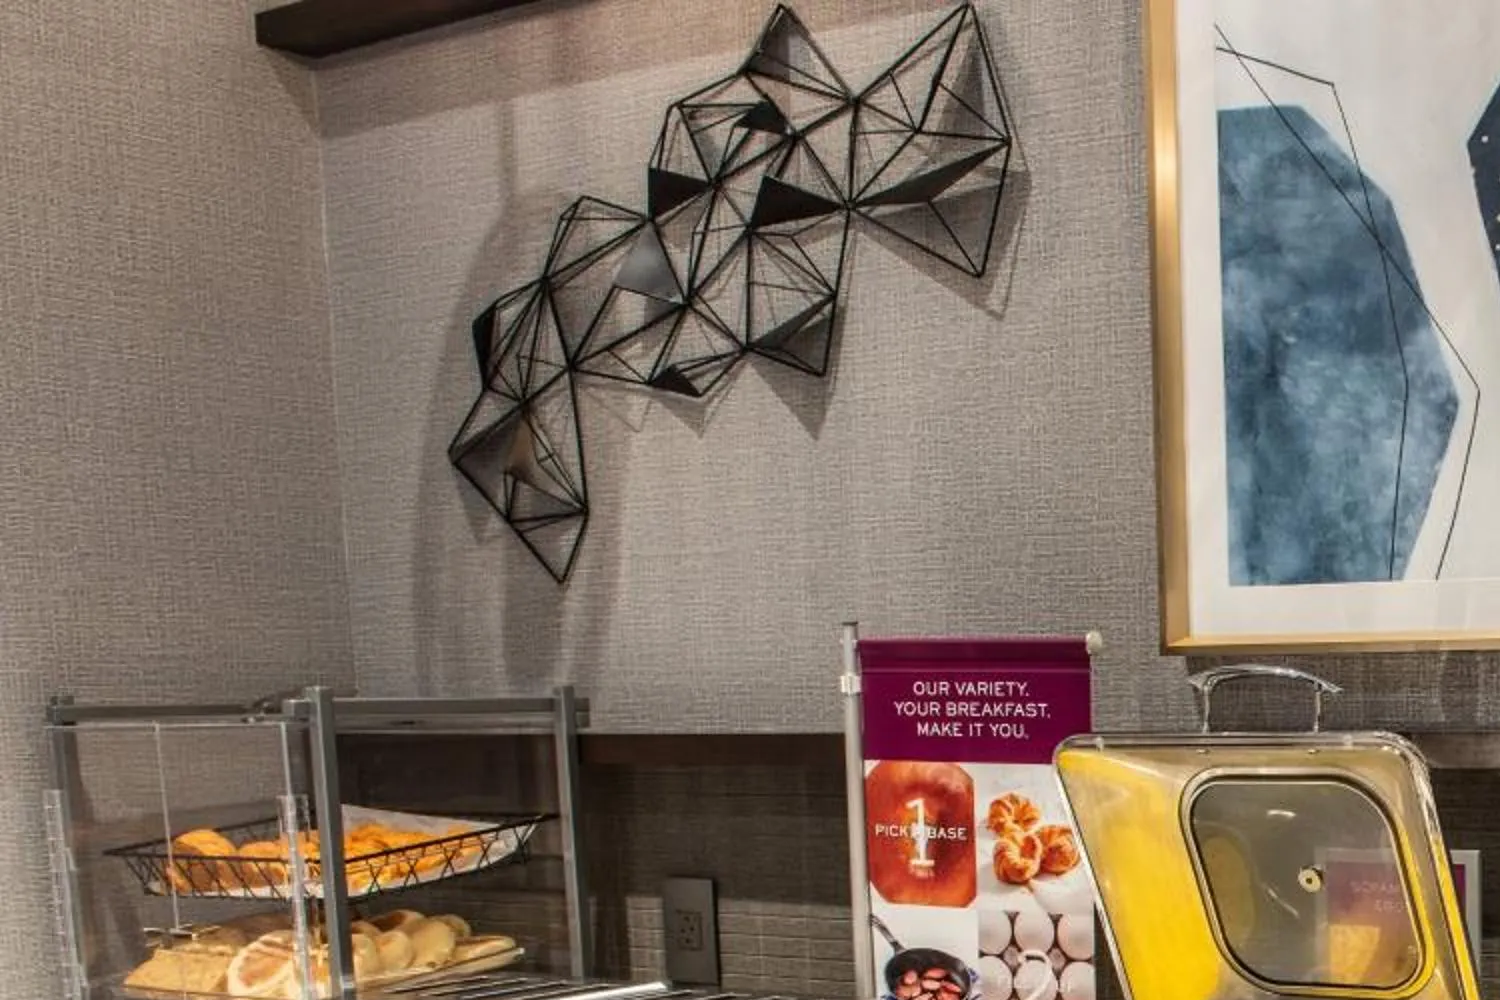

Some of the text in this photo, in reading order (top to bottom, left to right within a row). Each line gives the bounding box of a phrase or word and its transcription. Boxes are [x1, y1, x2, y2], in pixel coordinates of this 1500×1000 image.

[913, 681, 1030, 697] OUR VARIETY.
[894, 701, 1051, 718] YOUR BREAKFAST.
[917, 722, 1029, 739] MAKE IT YOU.
[875, 823, 908, 837] PICK
[927, 827, 968, 840] BASE
[905, 797, 935, 866] 1
